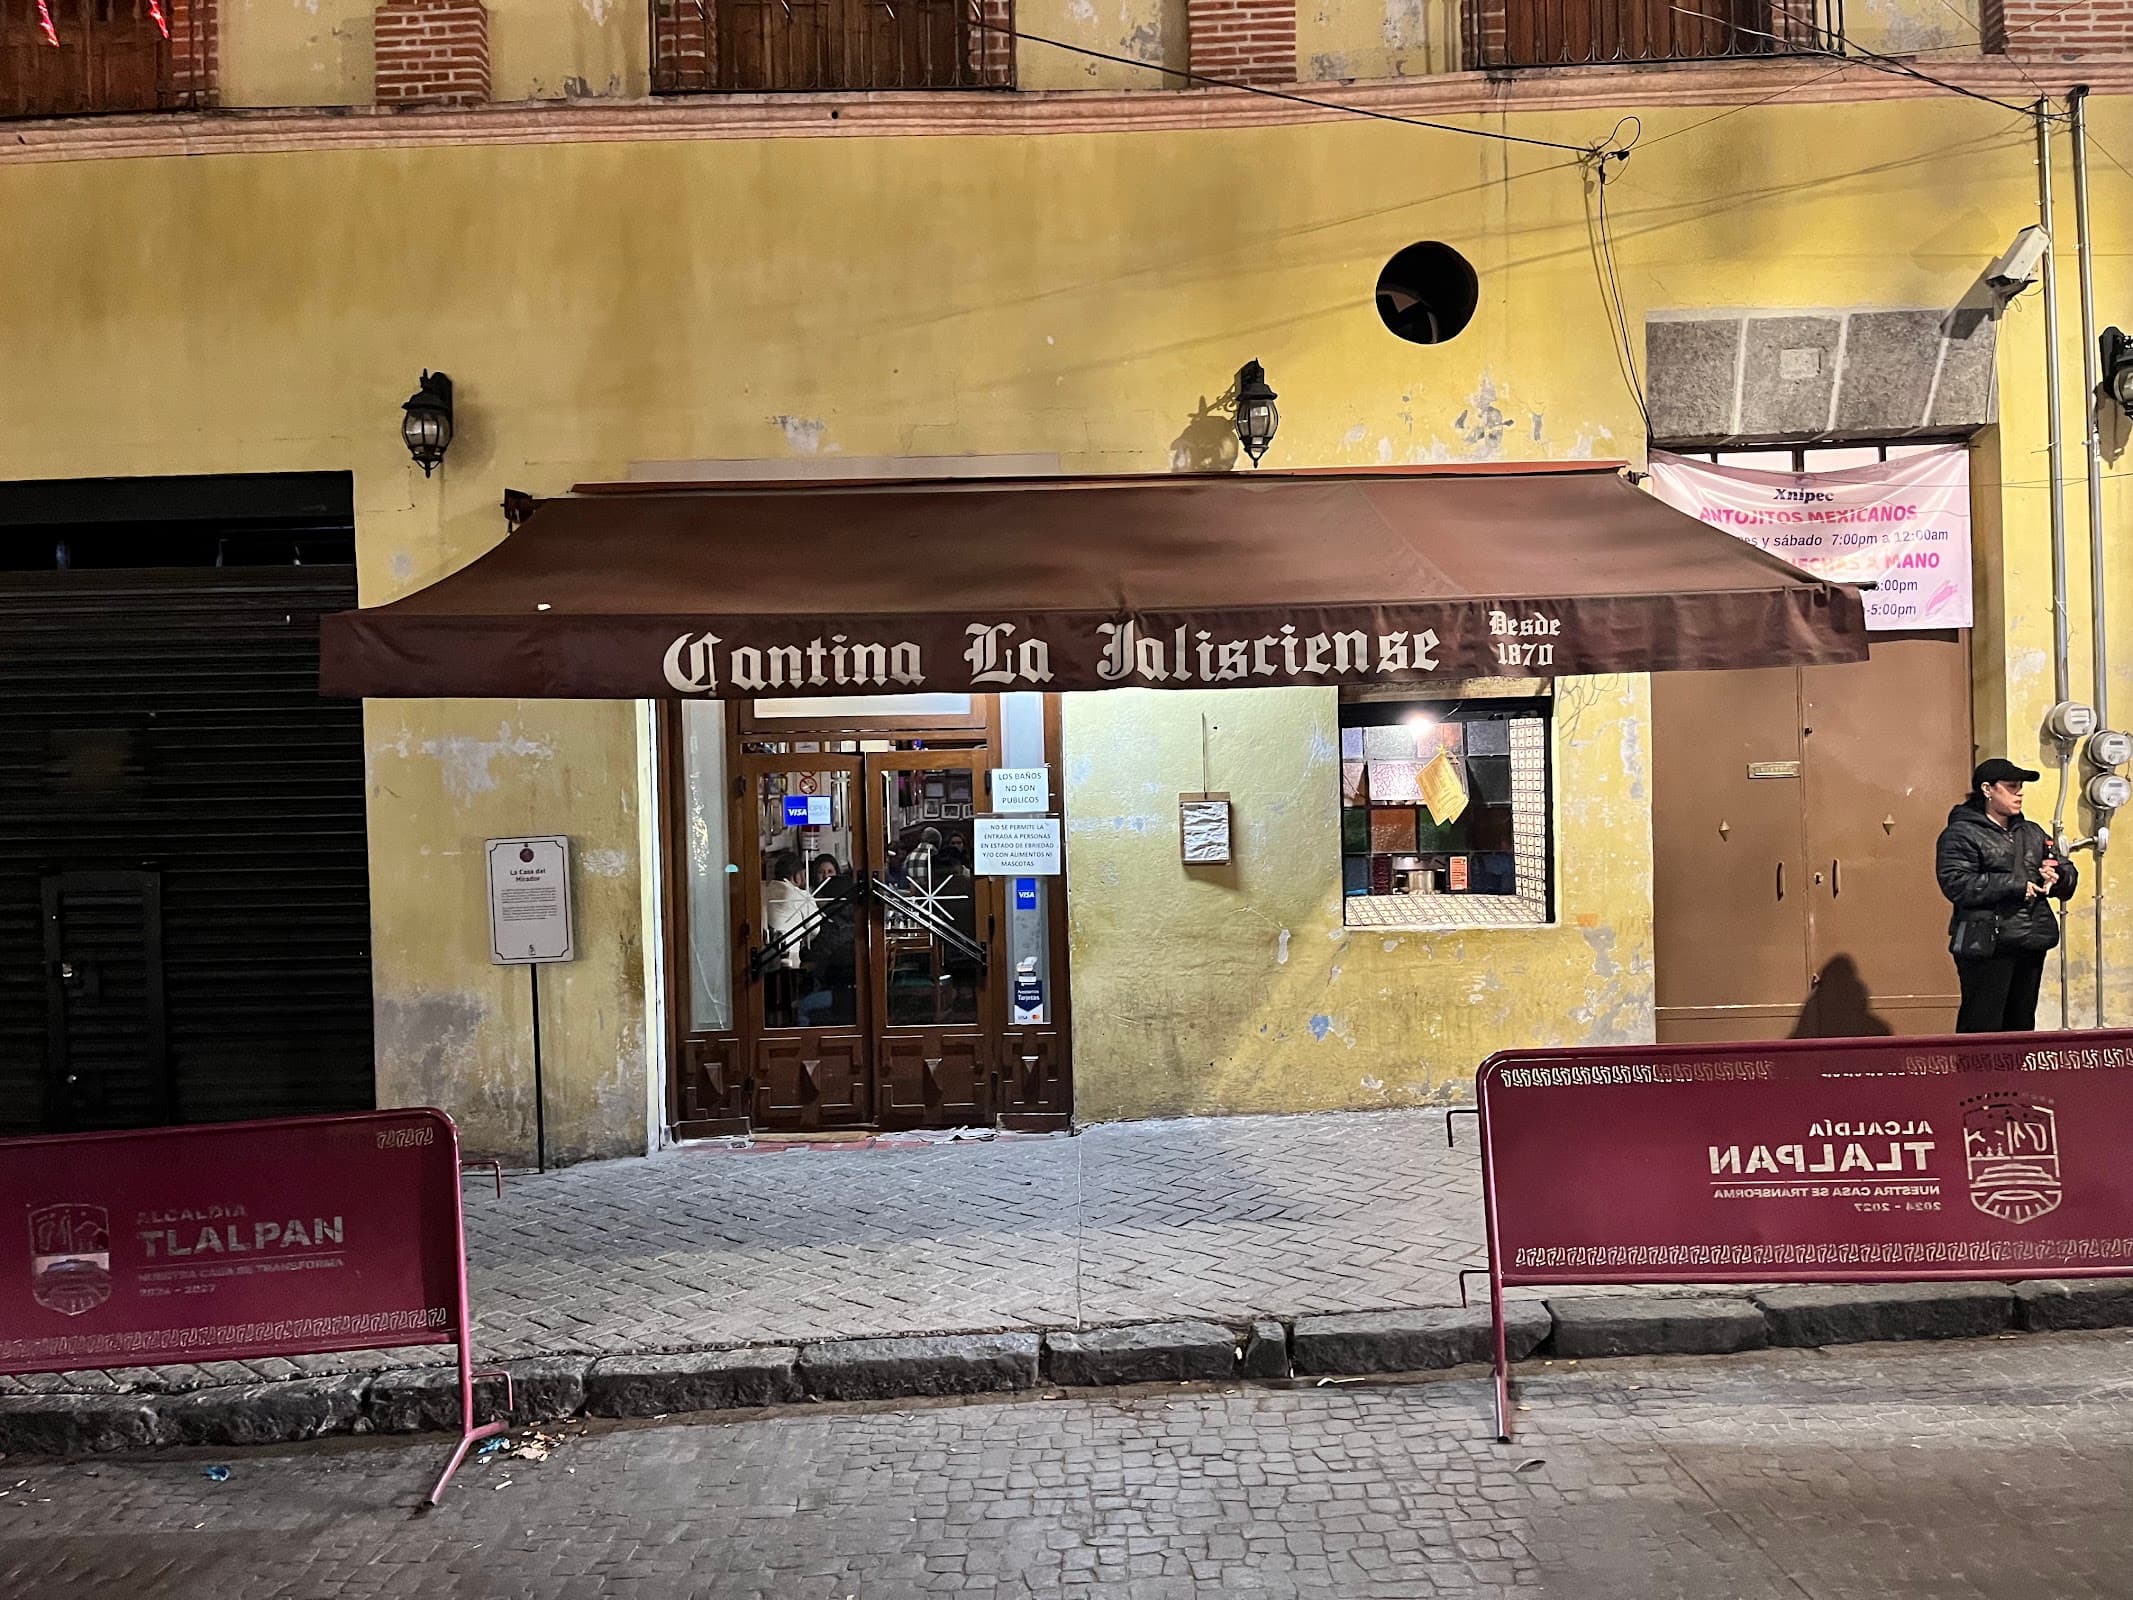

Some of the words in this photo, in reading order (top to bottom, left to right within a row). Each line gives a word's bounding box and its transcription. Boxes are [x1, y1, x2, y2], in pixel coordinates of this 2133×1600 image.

[1773, 488, 1834, 504] Xnipec
[1699, 507, 1802, 525] ANTOJITOS
[1808, 505, 1918, 523] MEXICANOS
[1762, 537, 1770, 549] y
[1773, 534, 1823, 546] sábado
[1832, 533, 1878, 548] 7:00pm
[1881, 534, 1891, 544] a
[1894, 529, 1948, 543] 12:00am
[1885, 552, 1940, 569] MANO
[1488, 610, 1561, 638] Desde
[663, 632, 926, 697] Cantina
[963, 622, 1055, 685] La
[1096, 619, 1440, 682] Jalisciense
[1496, 642, 1555, 667] 1870
[998, 773, 1013, 781] LOS
[1014, 771, 1042, 780] BAÑOS
[1005, 784, 1017, 792] NO
[1002, 796, 1039, 804] PUBLICOS
[788, 808, 808, 816] VISA
[138, 1215, 344, 1258] TLALPAN
